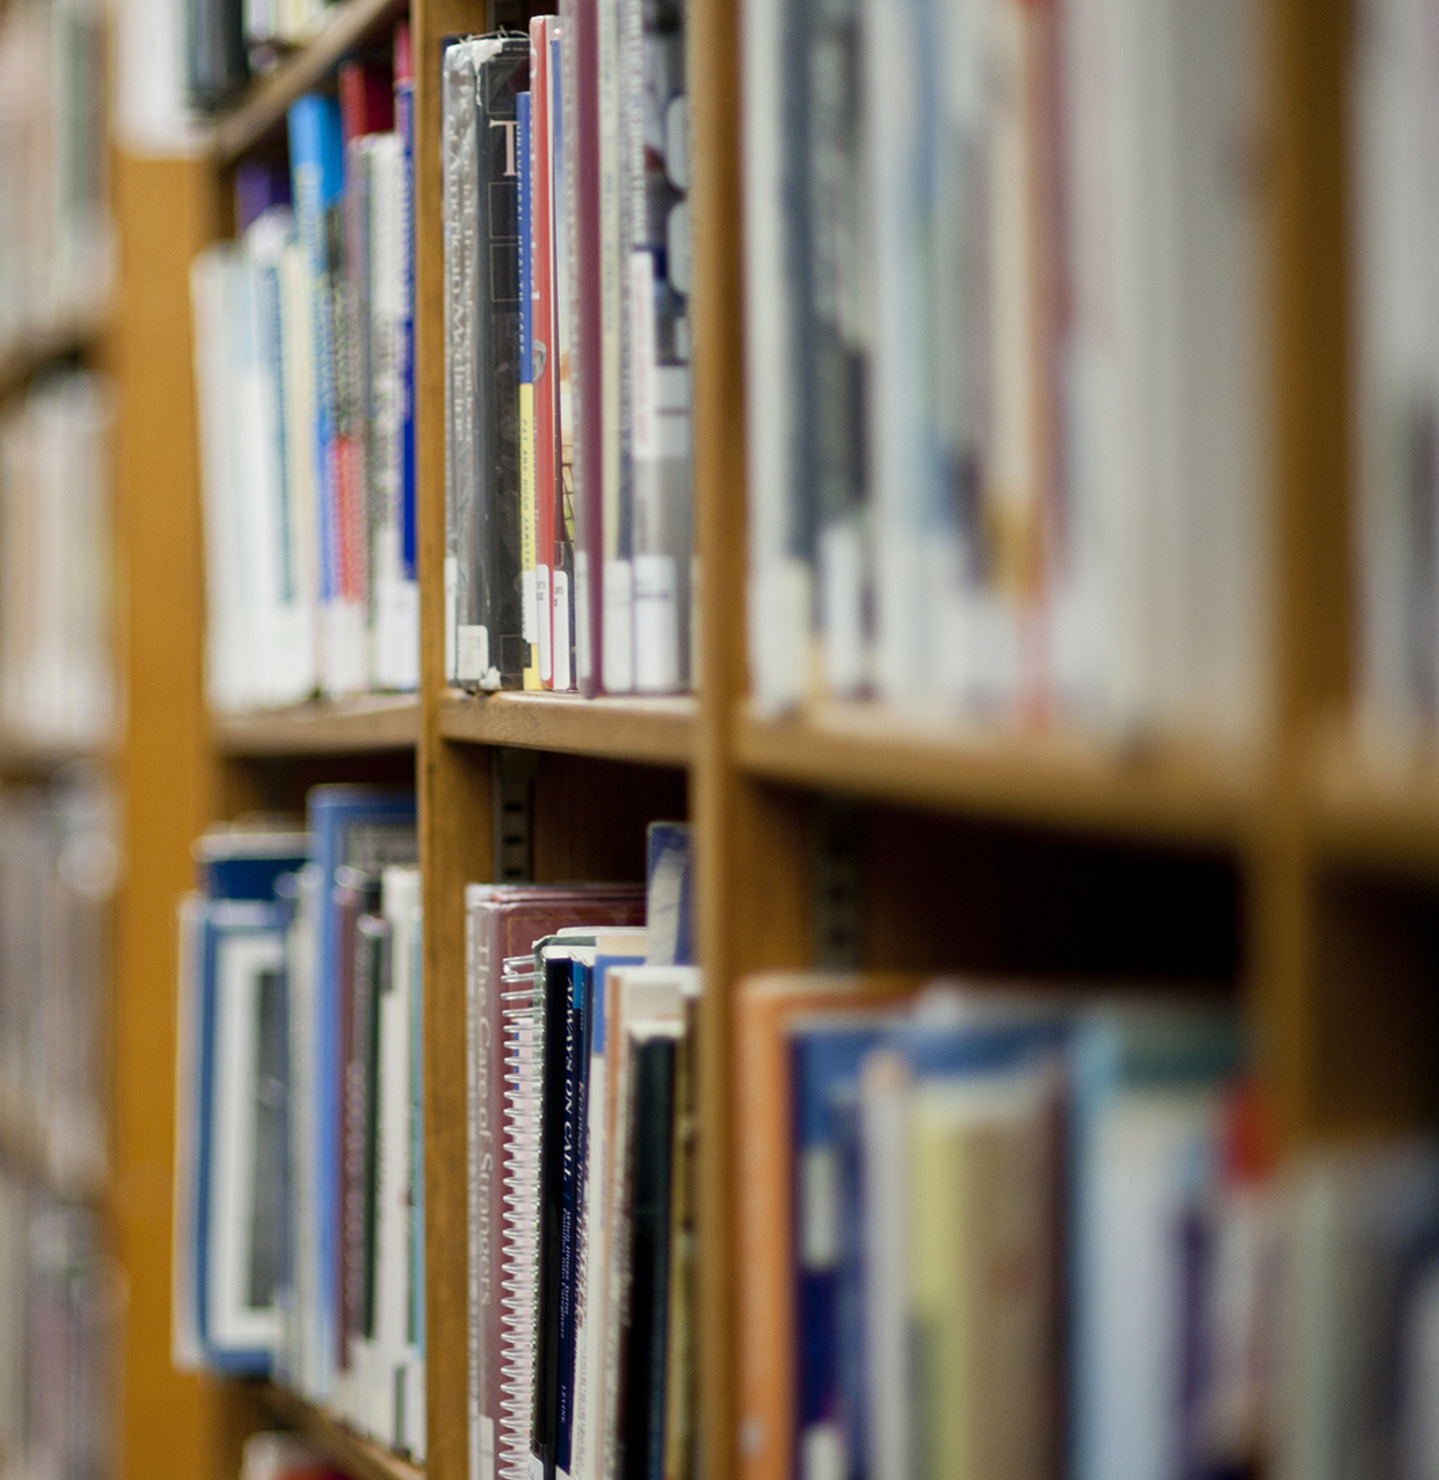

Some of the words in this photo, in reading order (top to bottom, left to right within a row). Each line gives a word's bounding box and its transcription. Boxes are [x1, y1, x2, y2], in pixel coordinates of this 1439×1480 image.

[516, 124, 524, 222] UNIVERSAL
[449, 150, 462, 294] American
[517, 235, 525, 303] HEALTH
[452, 303, 466, 442] Medicine
[477, 938, 491, 1005] The
[478, 1016, 492, 1100] Care
[565, 976, 574, 1073] ALWAYS
[478, 1106, 493, 1144] of
[564, 1078, 573, 1115] ON
[563, 1120, 572, 1182] CALL
[479, 1151, 494, 1306] Strangers
